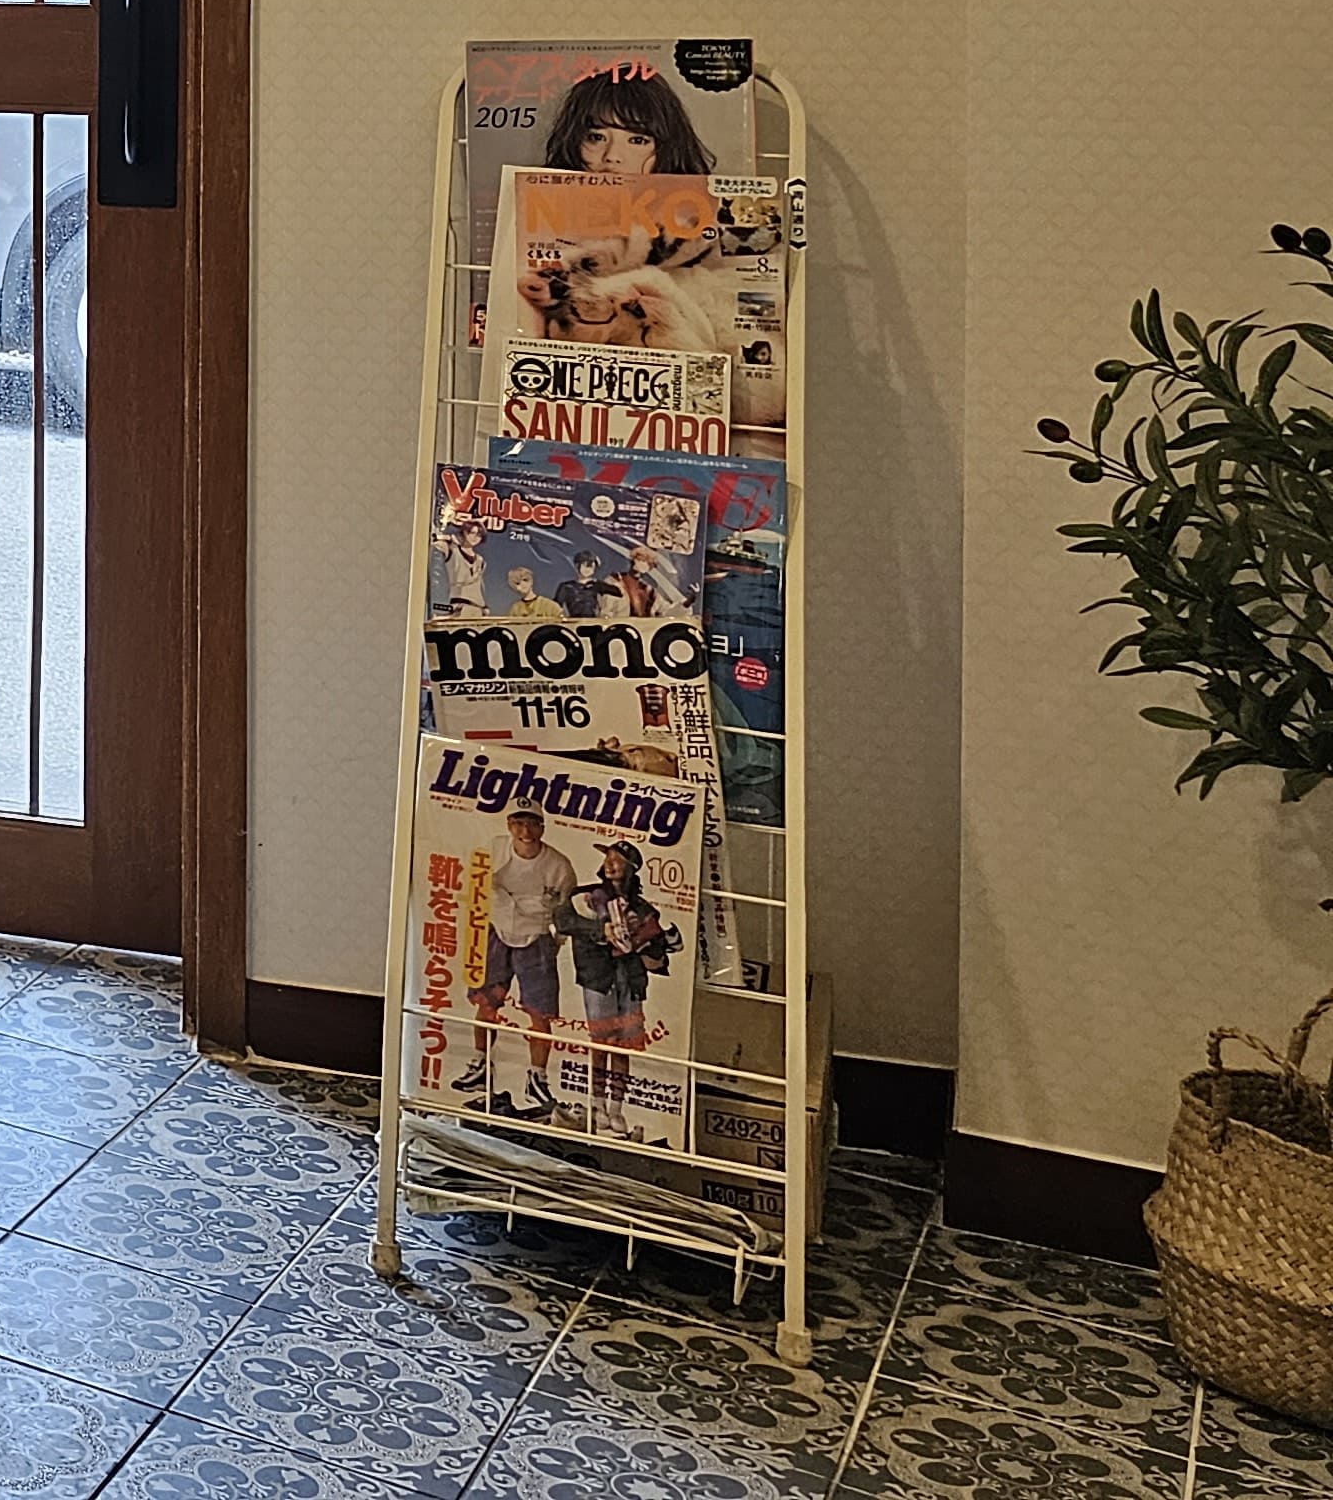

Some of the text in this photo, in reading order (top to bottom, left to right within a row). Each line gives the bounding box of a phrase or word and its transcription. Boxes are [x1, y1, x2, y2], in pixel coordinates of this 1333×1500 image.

[474, 54, 660, 85] ヘアスタイル
[474, 105, 537, 129] 2015
[526, 188, 714, 240] NEKO
[527, 250, 562, 260] くるくる
[757, 257, 769, 274] 8
[588, 363, 670, 409] PIECE
[671, 364, 682, 412] magazine
[442, 468, 572, 529] VTuber
[424, 623, 711, 680] mono
[441, 683, 506, 695] モノ・マガジン
[512, 695, 591, 729] 11-16
[429, 749, 695, 847] Lightning
[629, 781, 695, 802] ライトニング
[647, 857, 684, 889] 10
[466, 852, 491, 983] エイト・ビートで
